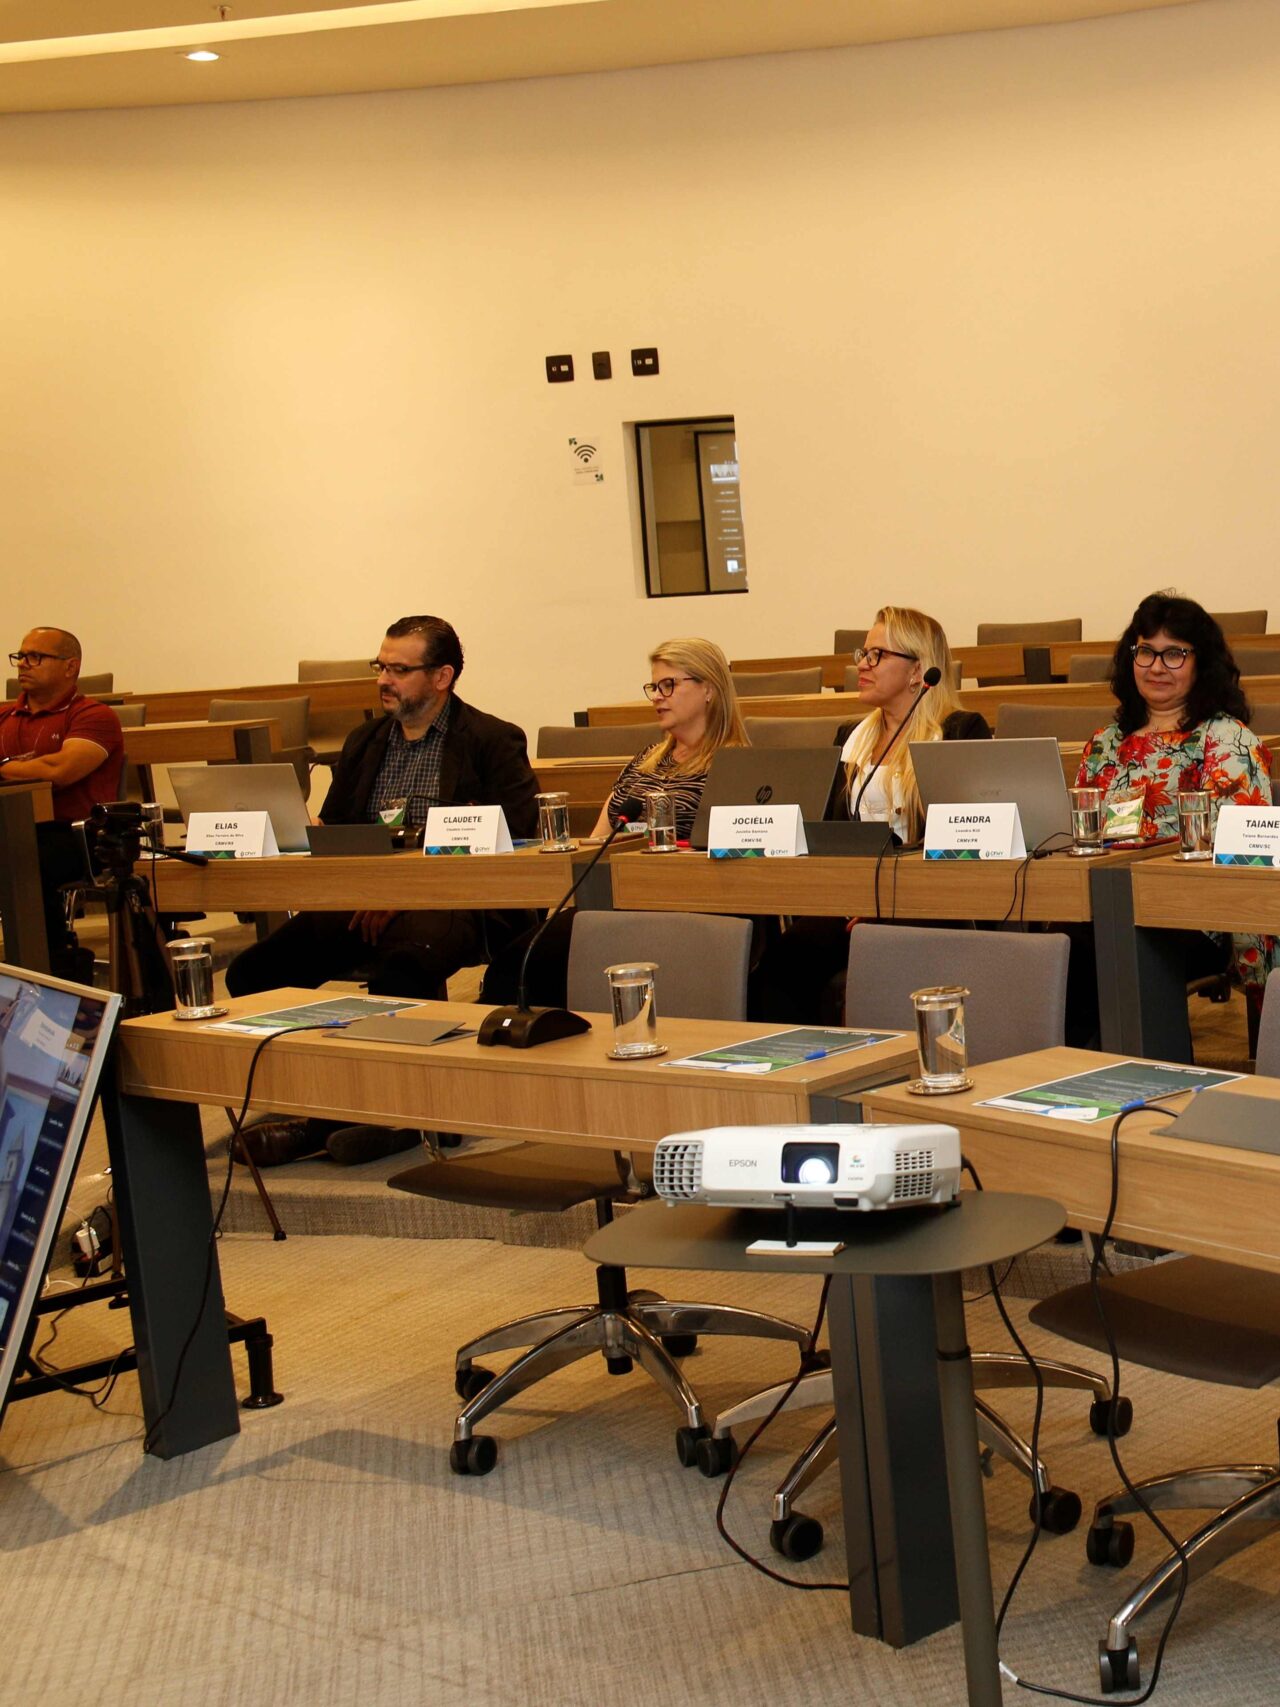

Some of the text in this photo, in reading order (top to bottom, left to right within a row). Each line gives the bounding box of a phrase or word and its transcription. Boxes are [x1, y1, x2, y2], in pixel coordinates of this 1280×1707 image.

[732, 816, 774, 825] JOCIÉLIA
[948, 816, 991, 824] LEANDRA
[1245, 819, 1280, 829] TAIANE
[728, 1159, 758, 1167] EPSON
